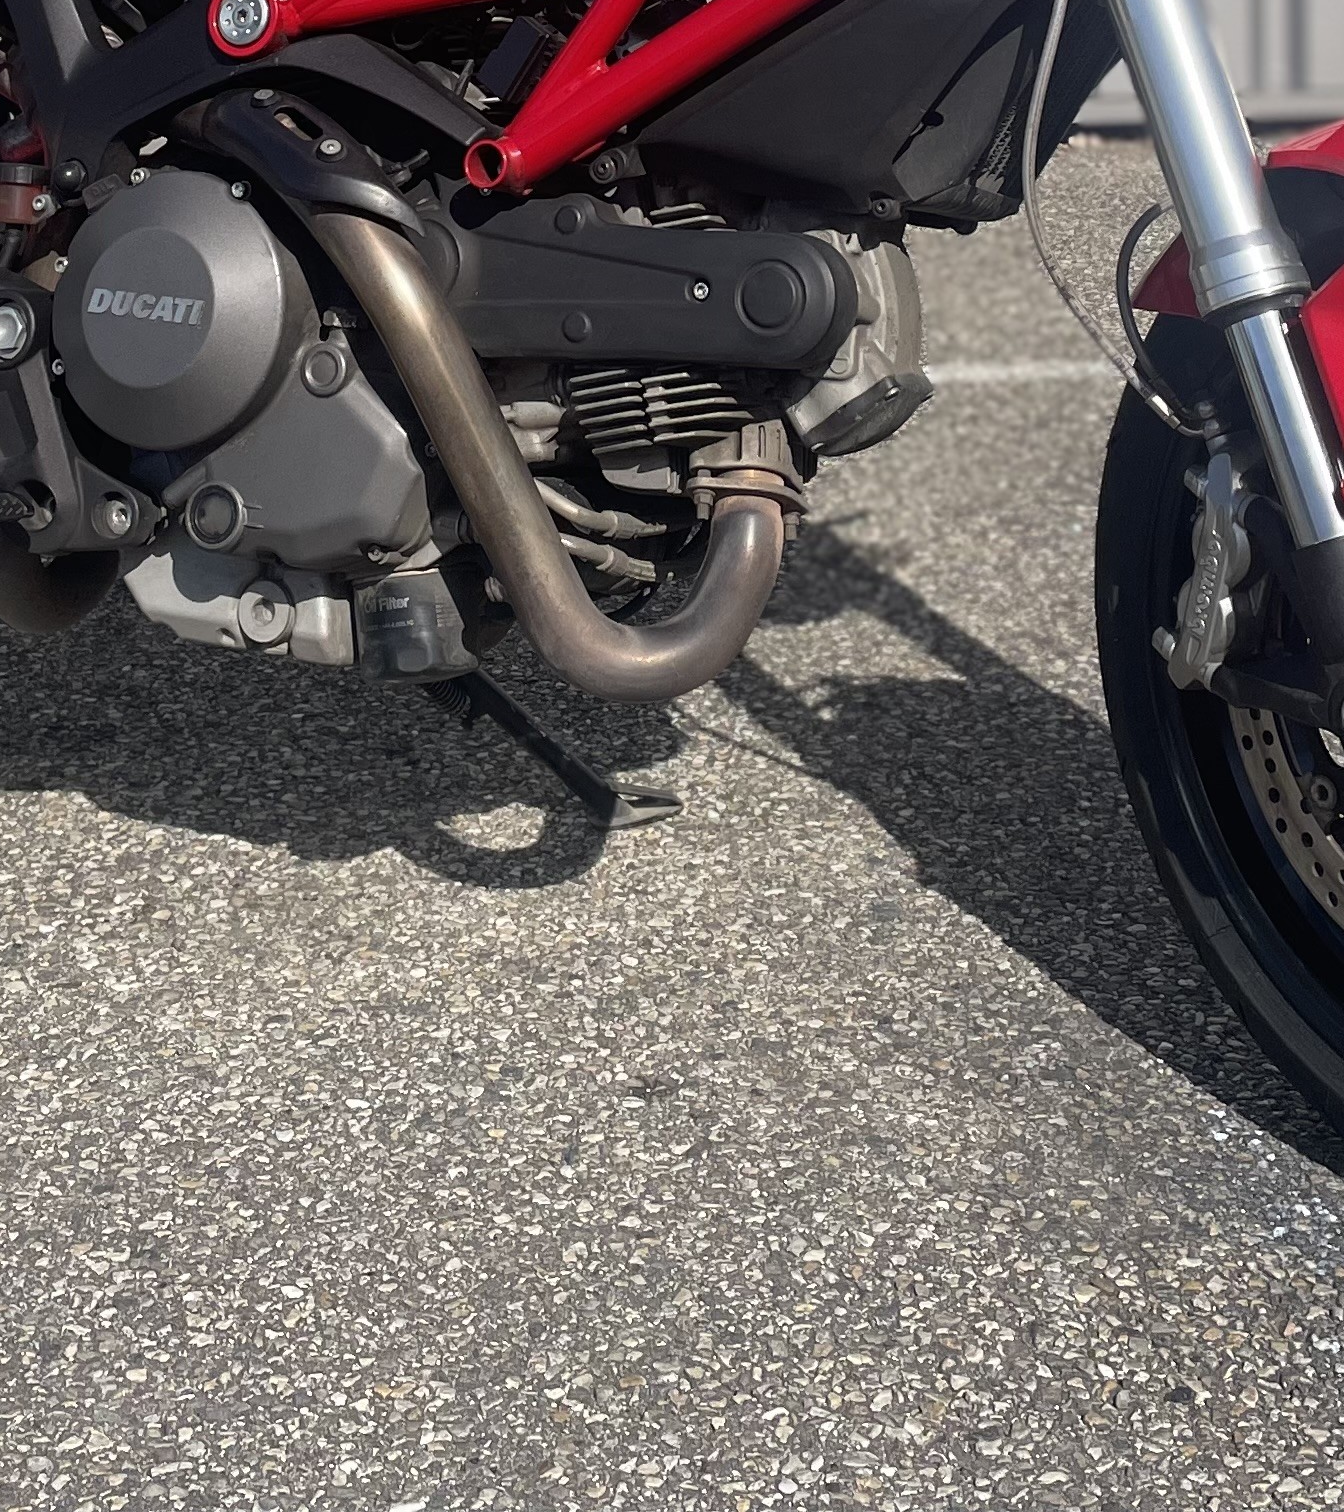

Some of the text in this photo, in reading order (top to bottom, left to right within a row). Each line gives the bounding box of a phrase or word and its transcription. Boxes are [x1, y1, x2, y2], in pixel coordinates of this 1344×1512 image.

[87, 287, 205, 326] DUCATI
[378, 595, 410, 611] Filter
[1187, 533, 1222, 634] brembo
